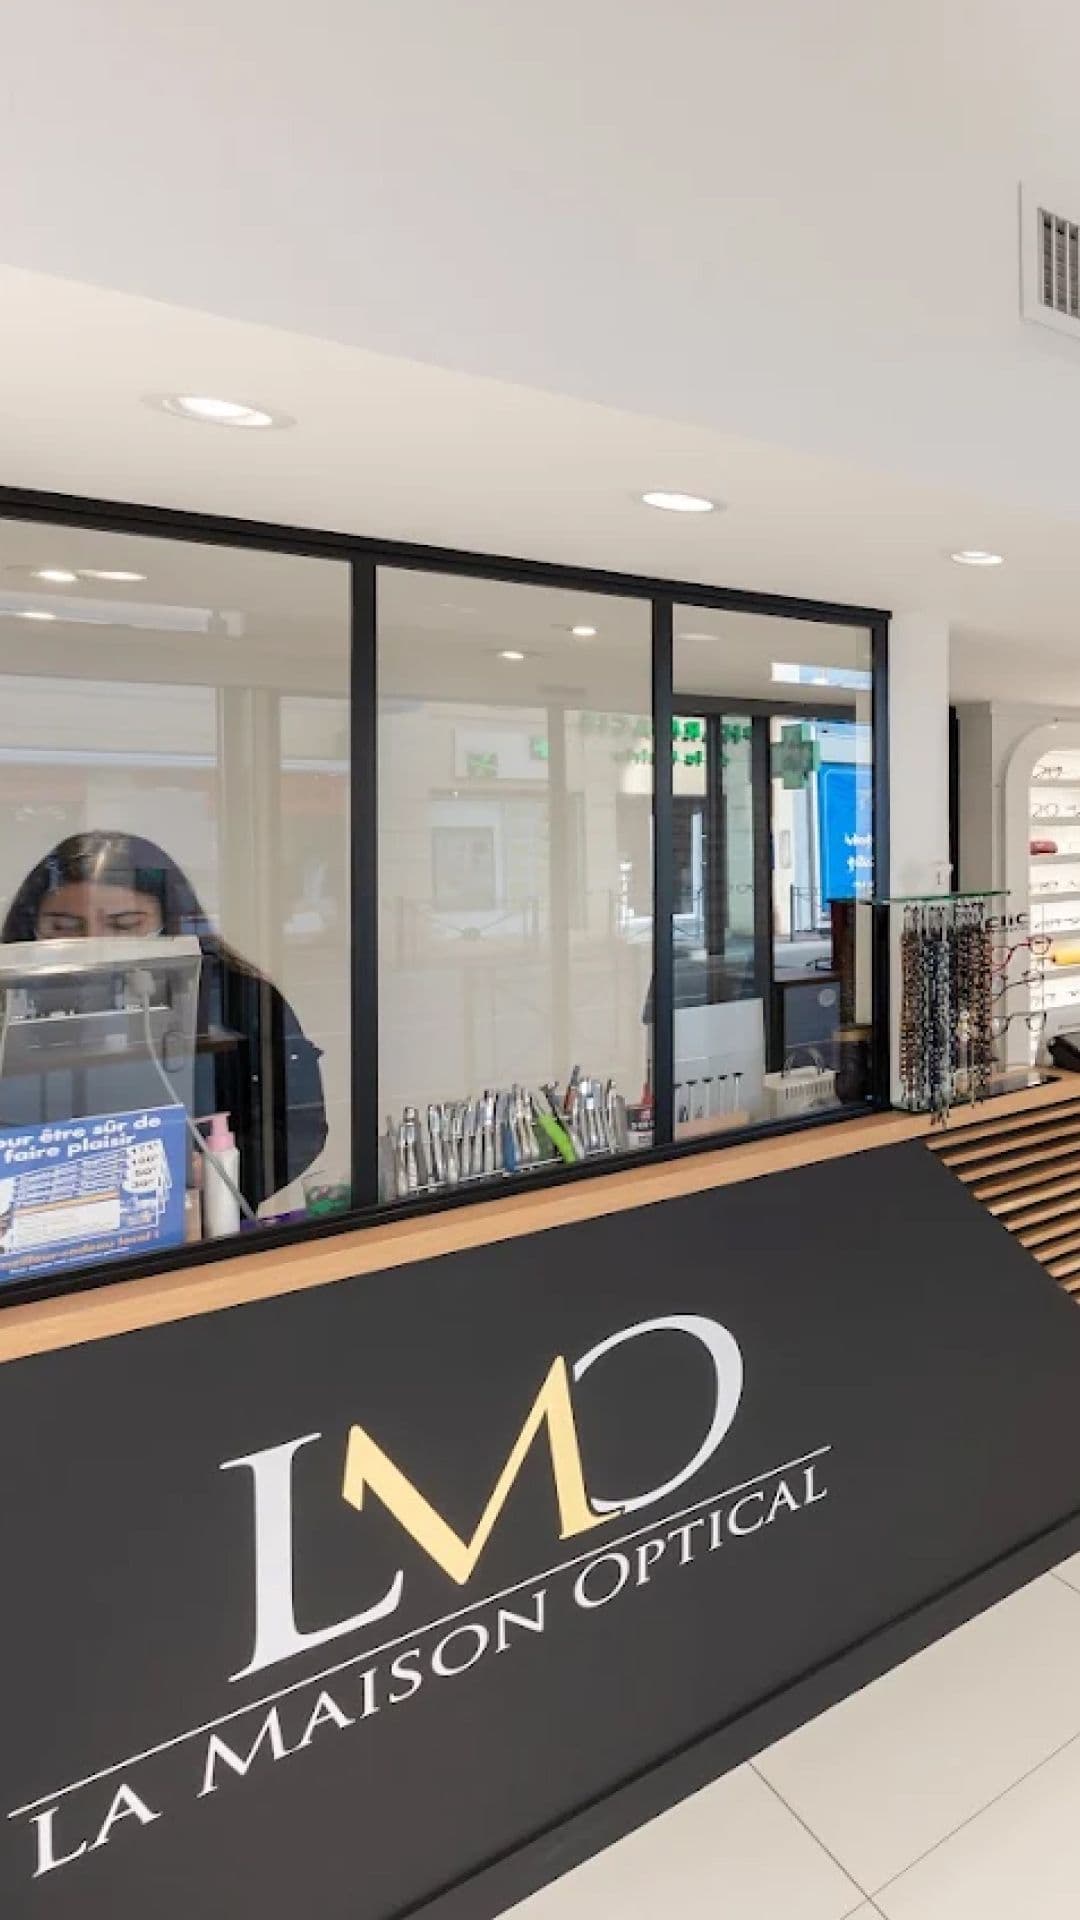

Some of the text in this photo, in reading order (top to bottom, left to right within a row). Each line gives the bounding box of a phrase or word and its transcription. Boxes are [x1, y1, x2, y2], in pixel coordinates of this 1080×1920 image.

[4, 1134, 136, 1164] faire plaisir
[39, 1127, 86, 1143] être
[92, 1120, 127, 1134] sûr
[133, 1115, 161, 1130] de
[219, 1313, 745, 1682] LMO
[31, 1467, 827, 1877] LA MAISON OPTICAL
